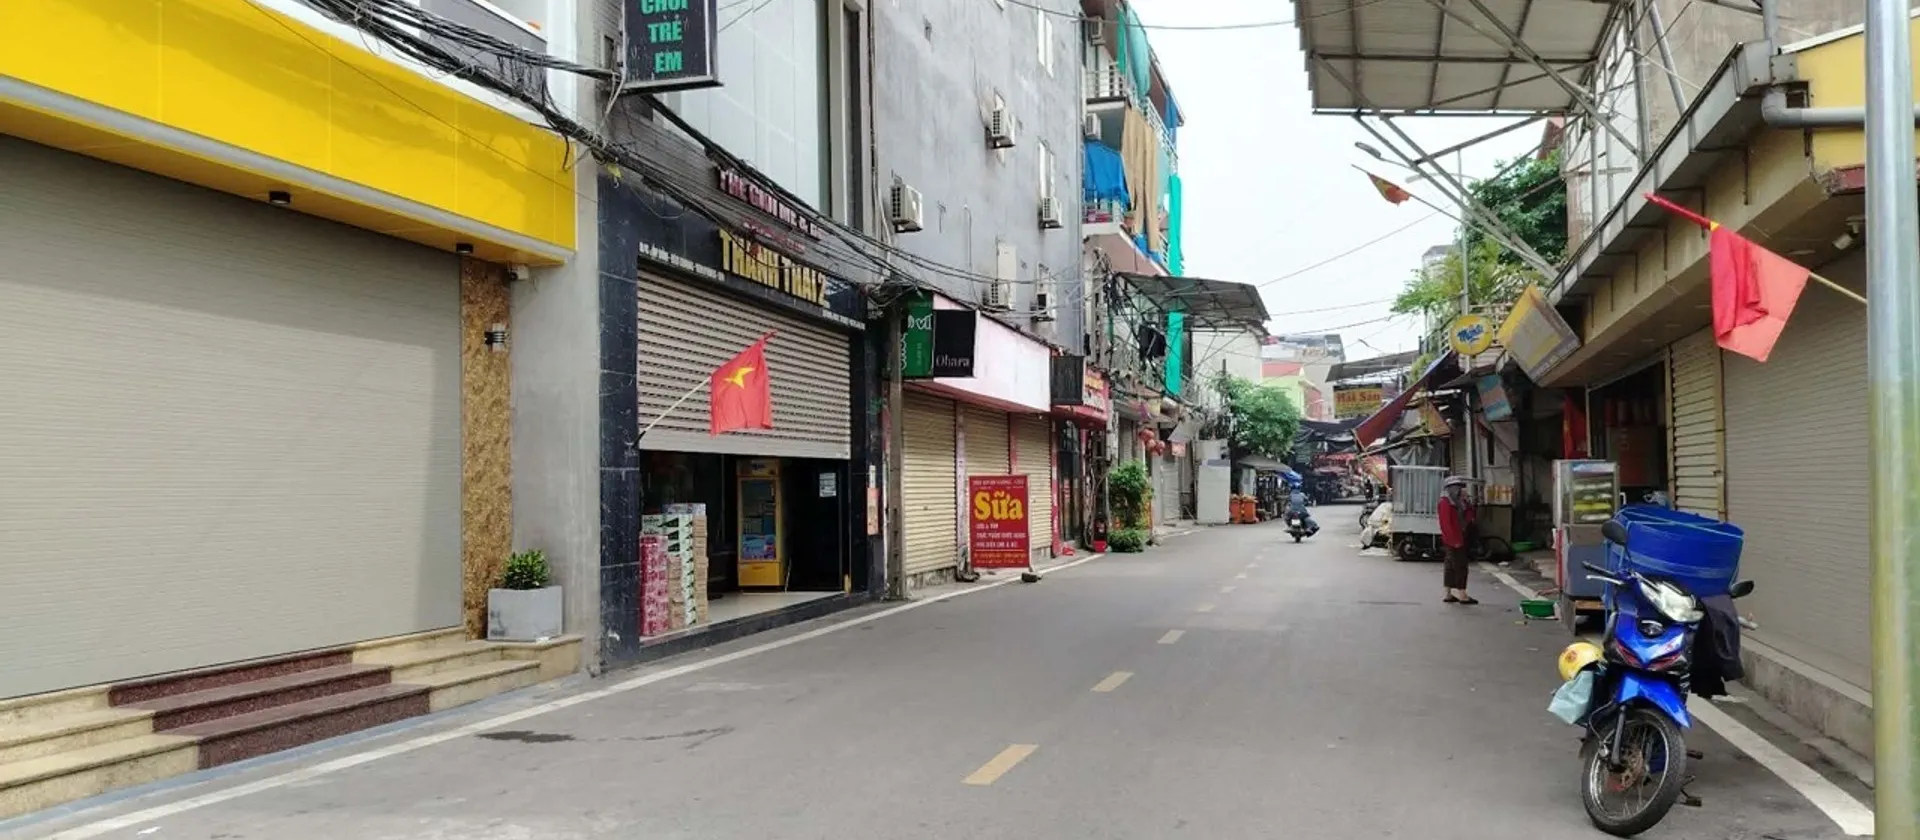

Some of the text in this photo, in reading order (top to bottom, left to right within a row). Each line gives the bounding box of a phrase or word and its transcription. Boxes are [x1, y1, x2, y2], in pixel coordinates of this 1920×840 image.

[654, 51, 683, 73] EM
[935, 354, 970, 369] Ohara
[974, 491, 1024, 521] Sữa
